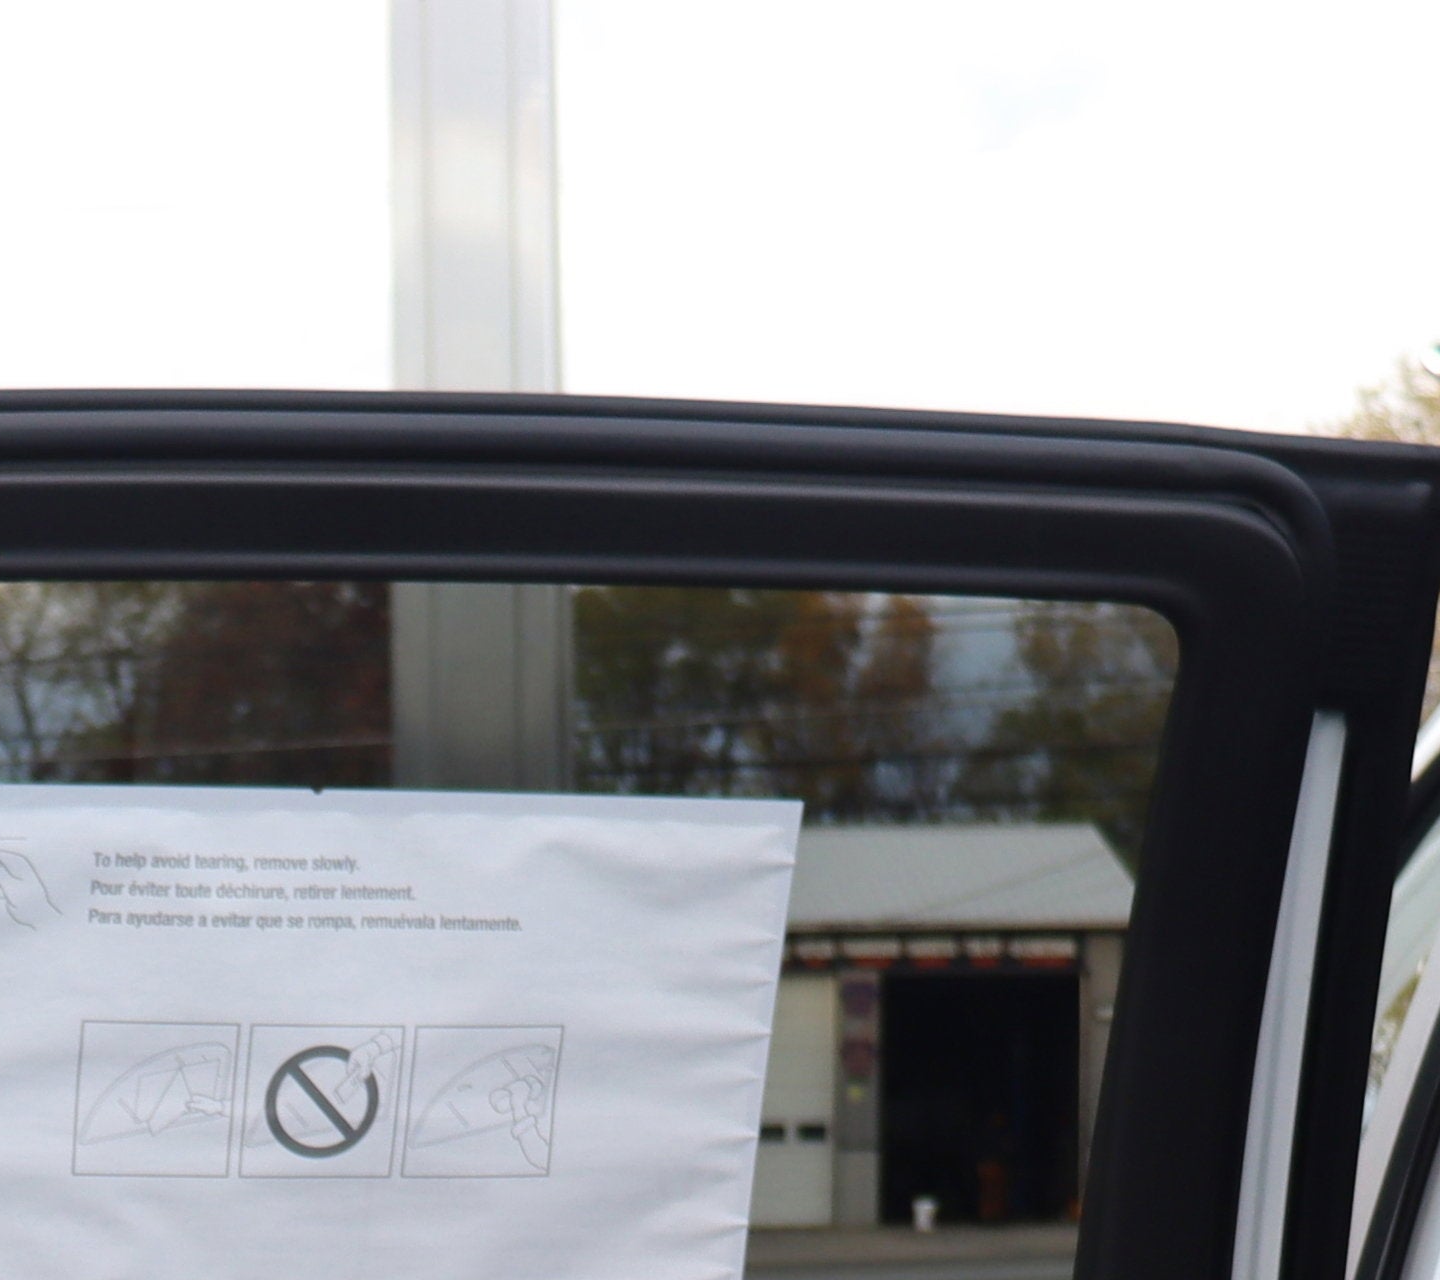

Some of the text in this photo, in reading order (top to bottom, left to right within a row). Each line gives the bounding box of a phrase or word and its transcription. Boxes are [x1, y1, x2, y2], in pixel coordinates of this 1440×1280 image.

[93, 852, 360, 873] To help avoid tearing, remove slowly.
[90, 880, 415, 901] Pour éviter toute déchirure, retirer lentement.
[88, 908, 523, 932] Para ayudarse a evitar que se rompa, remuévala lentamente.
